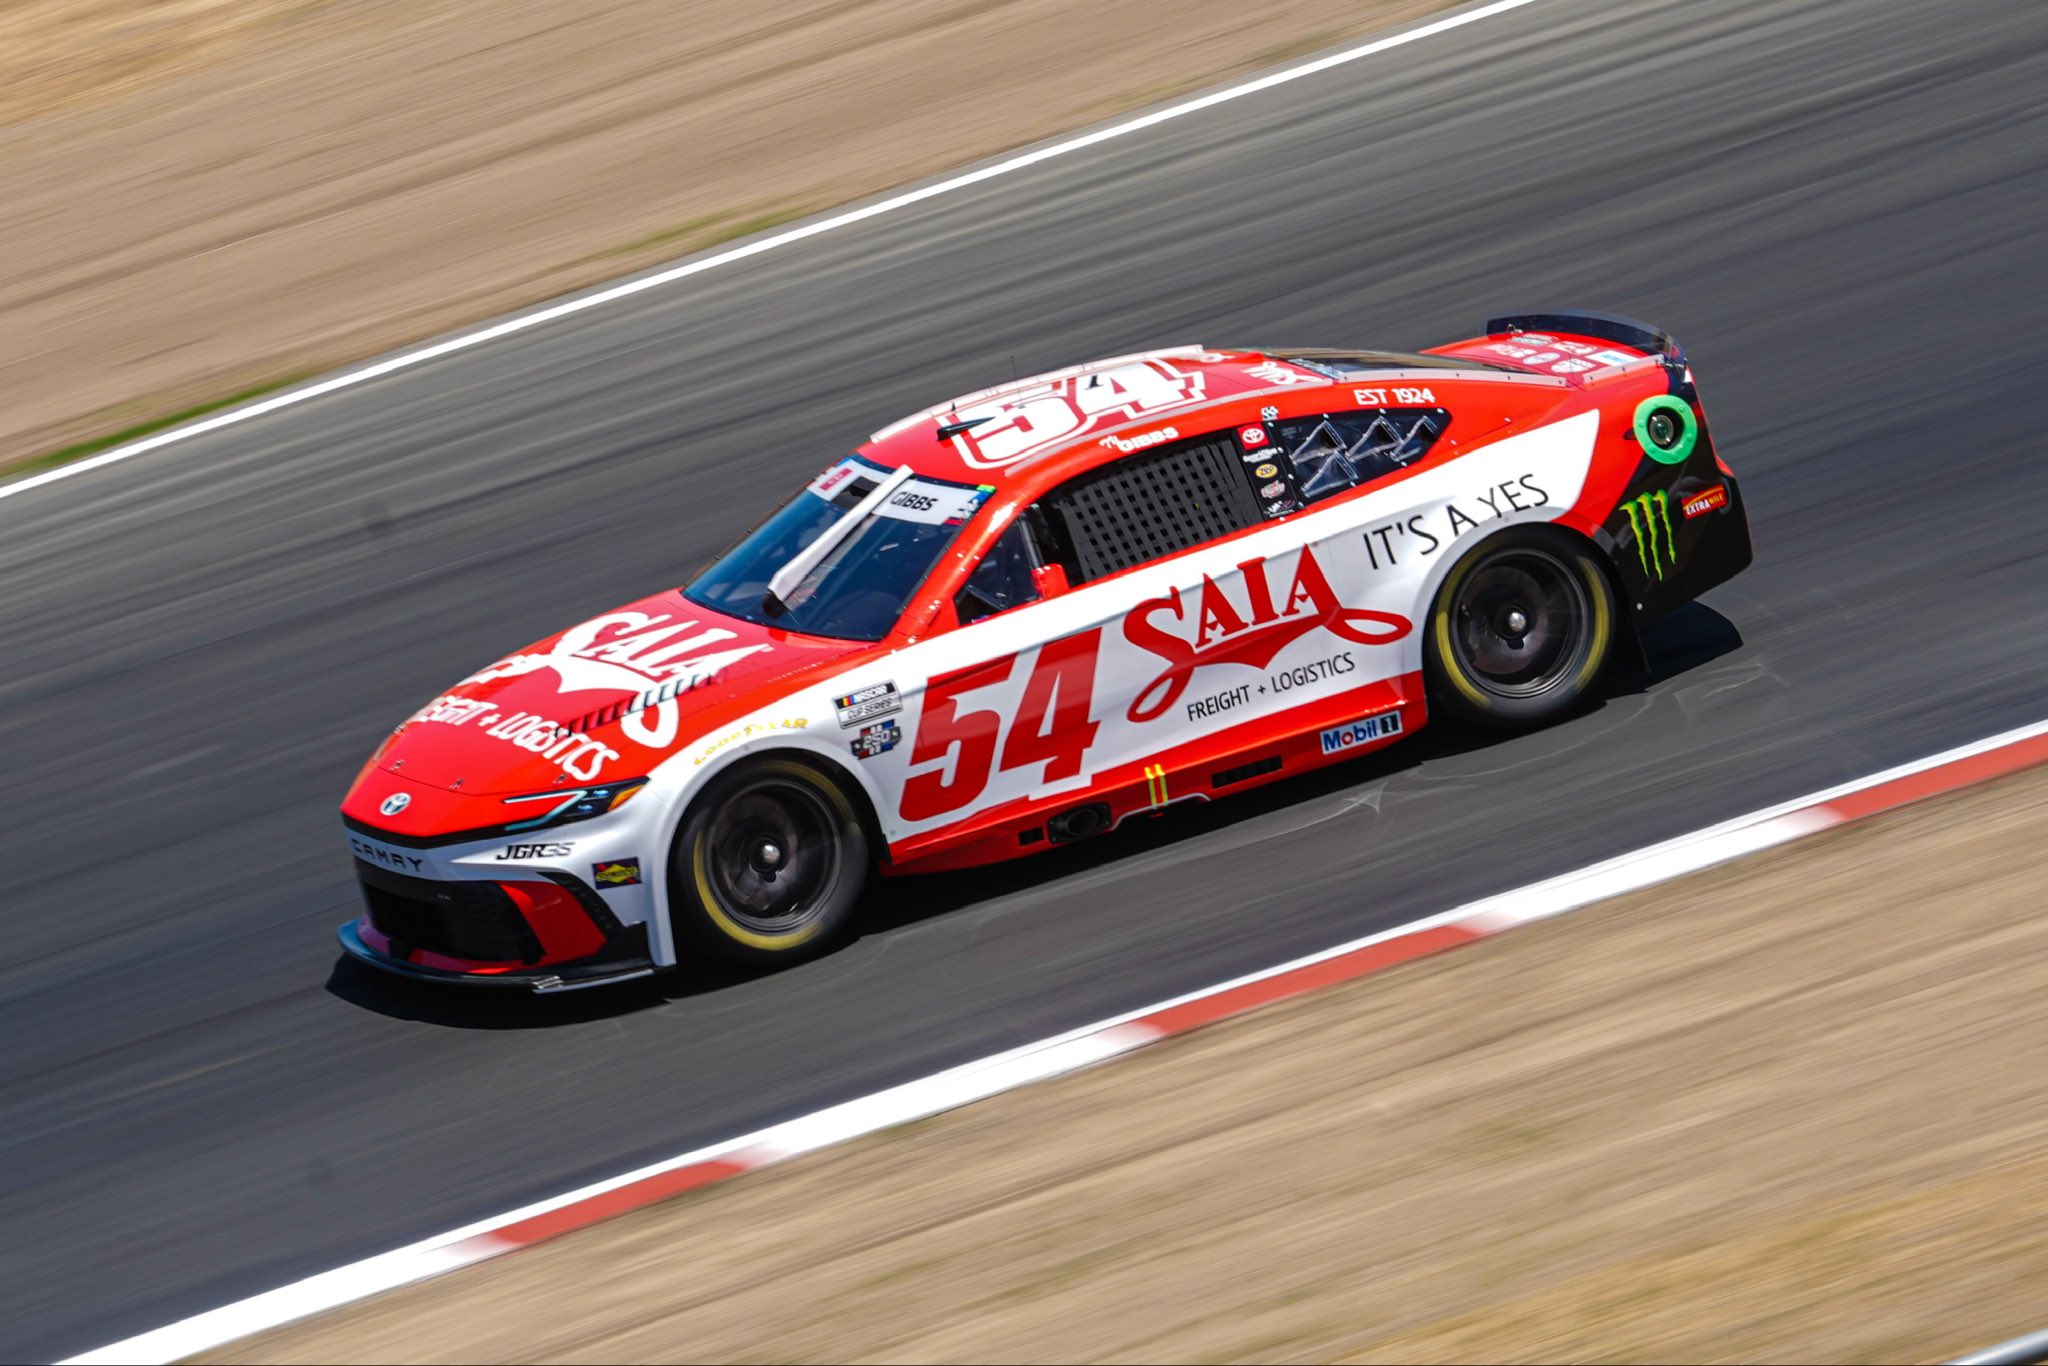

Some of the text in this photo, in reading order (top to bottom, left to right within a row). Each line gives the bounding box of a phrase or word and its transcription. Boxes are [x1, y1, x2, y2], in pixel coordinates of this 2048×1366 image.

[945, 358, 1200, 465] 54
[1353, 387, 1436, 405] EST 1924
[1117, 426, 1179, 452] GIBBS
[891, 491, 937, 512] GIBBS
[1363, 473, 1549, 570] IT'S A YES
[1187, 684, 1250, 722] FREIGHT
[1271, 652, 1355, 693] LOGISTICS
[865, 698, 893, 714] SERIES
[862, 729, 890, 749] 250
[899, 626, 1103, 822] 54
[1323, 720, 1378, 751] Mobil
[486, 712, 620, 781] LOGISTICS
[351, 838, 423, 872] CAMRY
